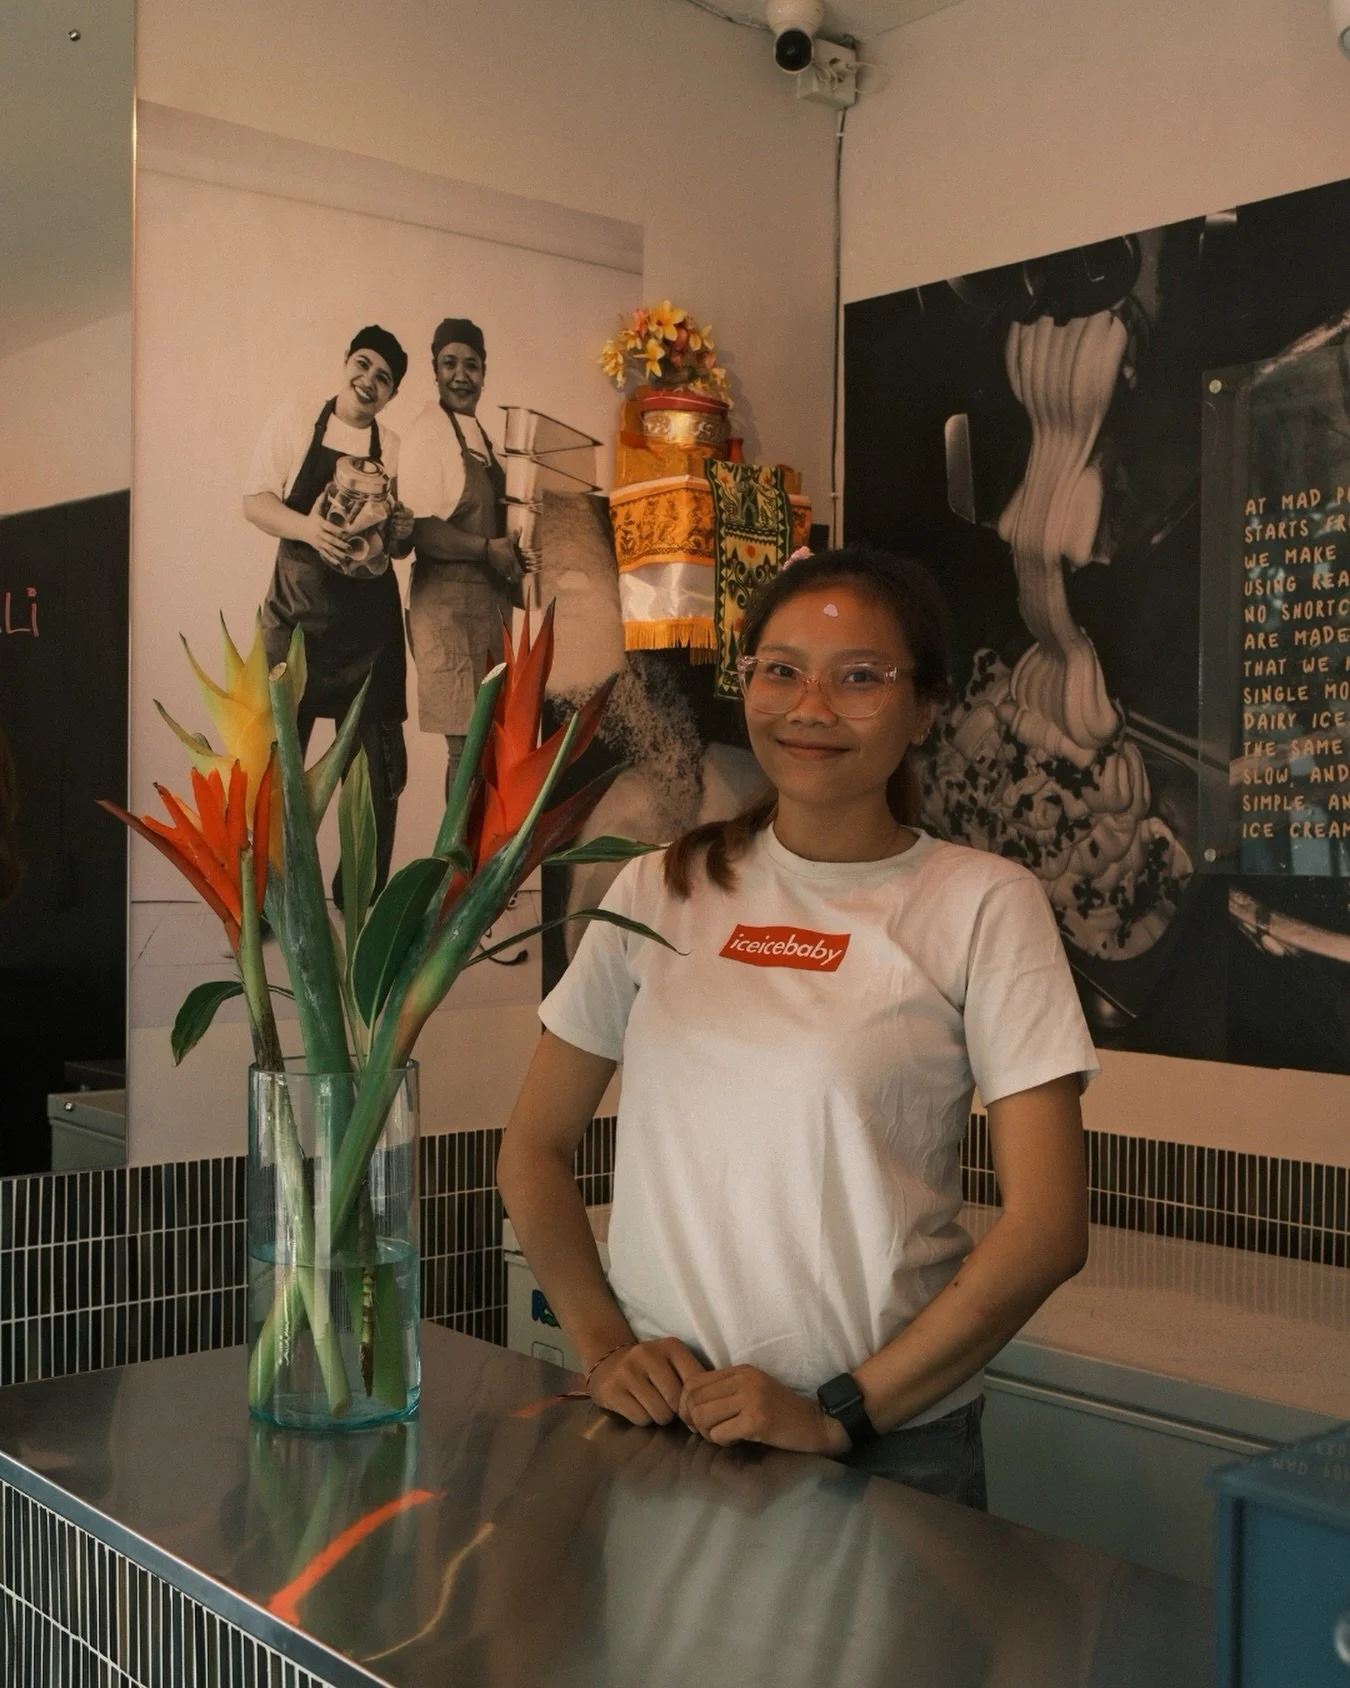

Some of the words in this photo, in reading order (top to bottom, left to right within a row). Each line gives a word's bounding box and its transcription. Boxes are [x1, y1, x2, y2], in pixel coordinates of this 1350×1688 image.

[1245, 497, 1266, 516] AT
[1281, 488, 1321, 510] MAD
[1336, 486, 1350, 505] P
[1244, 519, 1309, 544] STARTS
[1325, 513, 1350, 532] FR
[1244, 552, 1270, 570] WE
[1284, 545, 1337, 565] MAKE
[1244, 576, 1297, 597] USING
[1312, 570, 1350, 591] REA
[1244, 604, 1267, 624] NO
[1281, 599, 1350, 622] SHORTC
[1244, 632, 1279, 651] ARE
[1294, 625, 1350, 648] MADE
[1243, 658, 1287, 677] THAT
[1302, 656, 1329, 673] WE
[1243, 685, 1309, 705] SINGLE
[1324, 681, 1350, 700] MO
[1243, 712, 1297, 731] DAIRY
[1312, 711, 1346, 729] ICE
[1242, 741, 1276, 758] THE
[1290, 739, 1343, 757] SAME
[1310, 763, 1350, 784] AND
[1242, 822, 1274, 839] ICE
[729, 933, 842, 966] iceicebaby
